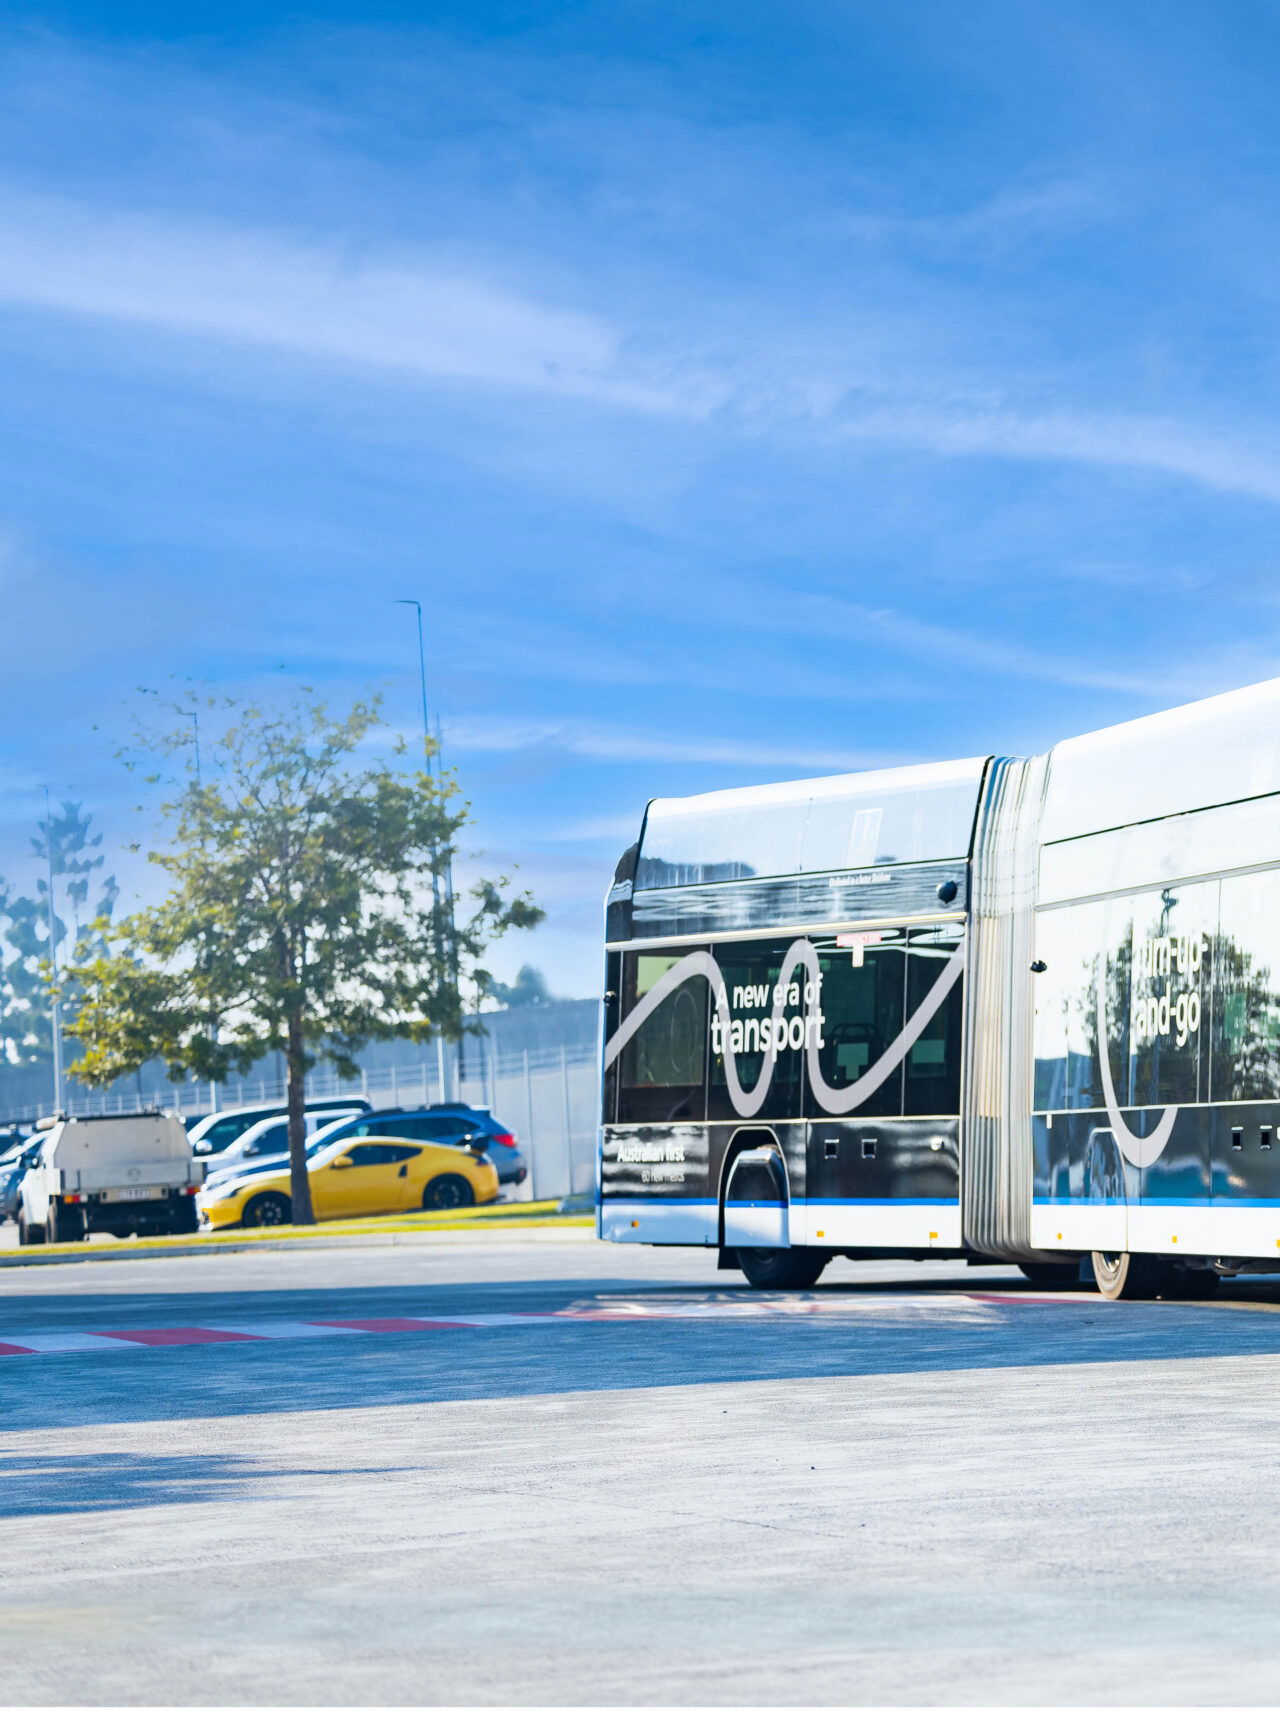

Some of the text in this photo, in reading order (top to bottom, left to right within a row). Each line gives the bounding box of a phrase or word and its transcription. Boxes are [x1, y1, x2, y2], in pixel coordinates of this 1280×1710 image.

[715, 973, 823, 1010] A new era of
[1135, 981, 1201, 1047] and-go
[711, 1008, 825, 1062] transport
